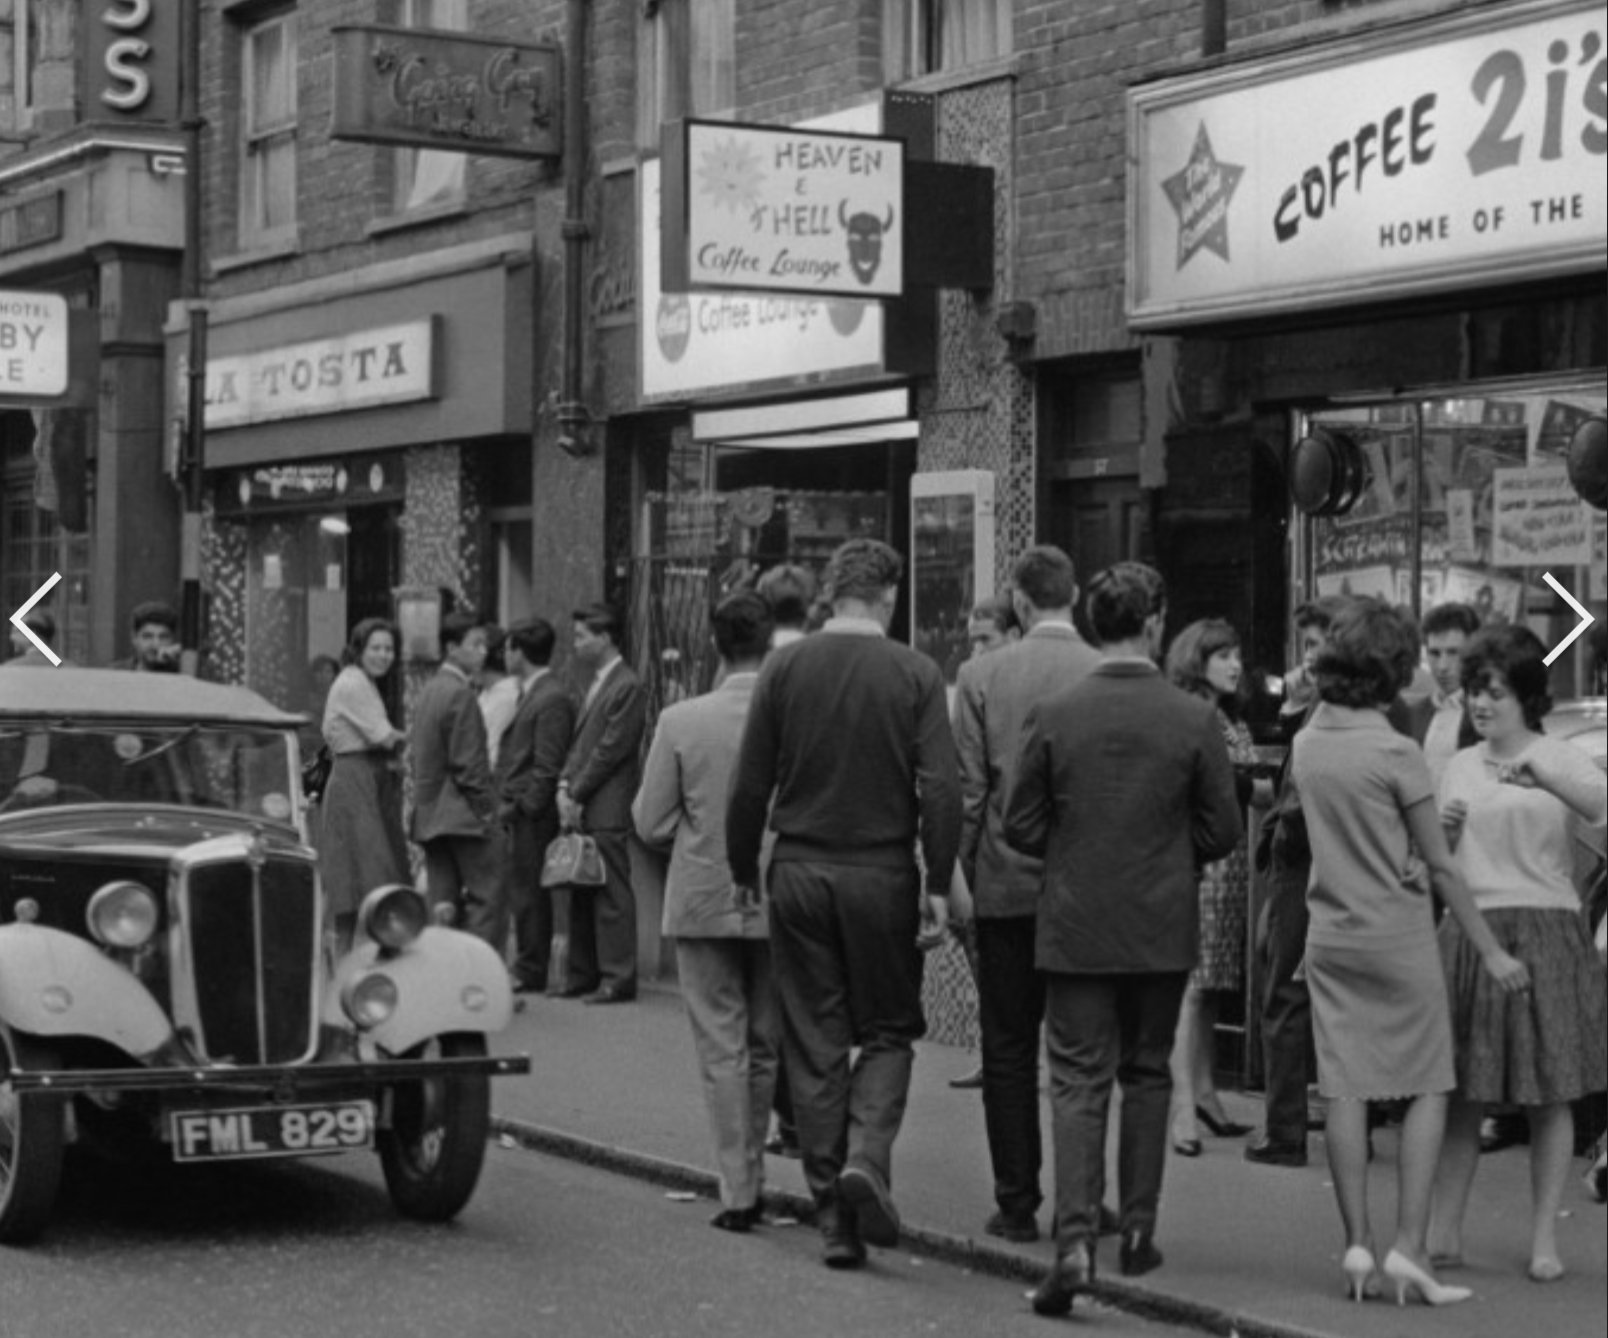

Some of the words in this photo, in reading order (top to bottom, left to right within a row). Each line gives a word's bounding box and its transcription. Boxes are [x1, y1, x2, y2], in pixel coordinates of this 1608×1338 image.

[775, 141, 882, 175] HEAVEN
[1274, 92, 1438, 242] COFFEE
[773, 203, 832, 236] HELL
[1380, 215, 1450, 247] HOME
[1473, 206, 1505, 233] OF
[1531, 194, 1583, 224] THE
[697, 241, 761, 277] Coffee
[769, 247, 842, 283] Lounge
[262, 342, 407, 396] TOSTA
[182, 1114, 268, 1155] FML
[281, 1108, 366, 1149] 829
